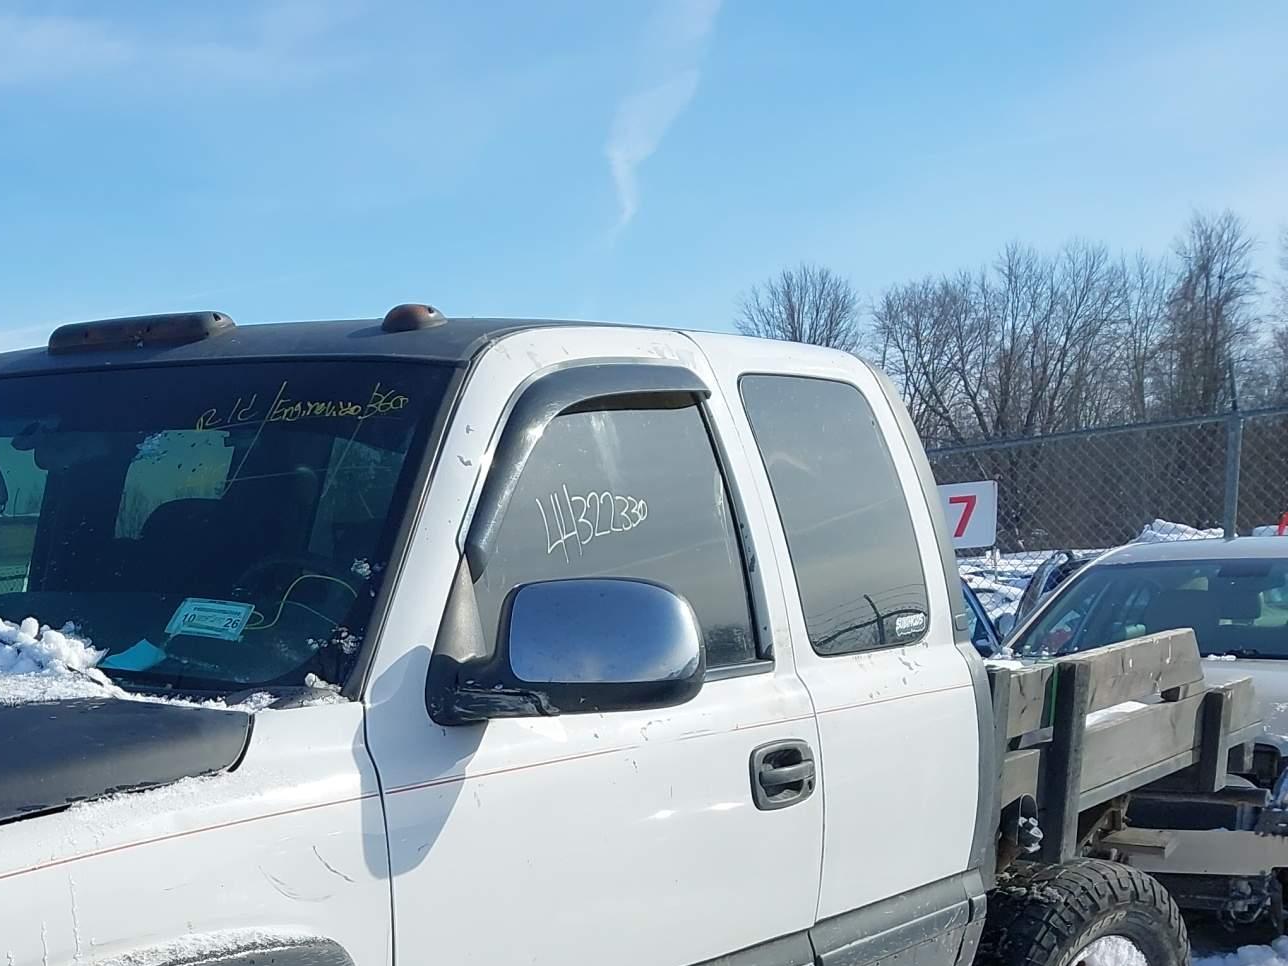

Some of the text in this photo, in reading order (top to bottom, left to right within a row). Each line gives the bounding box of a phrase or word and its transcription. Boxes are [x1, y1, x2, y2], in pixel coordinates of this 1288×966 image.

[536, 484, 648, 564] 44322330
[949, 495, 976, 538] 7
[182, 612, 240, 629] 10 26
